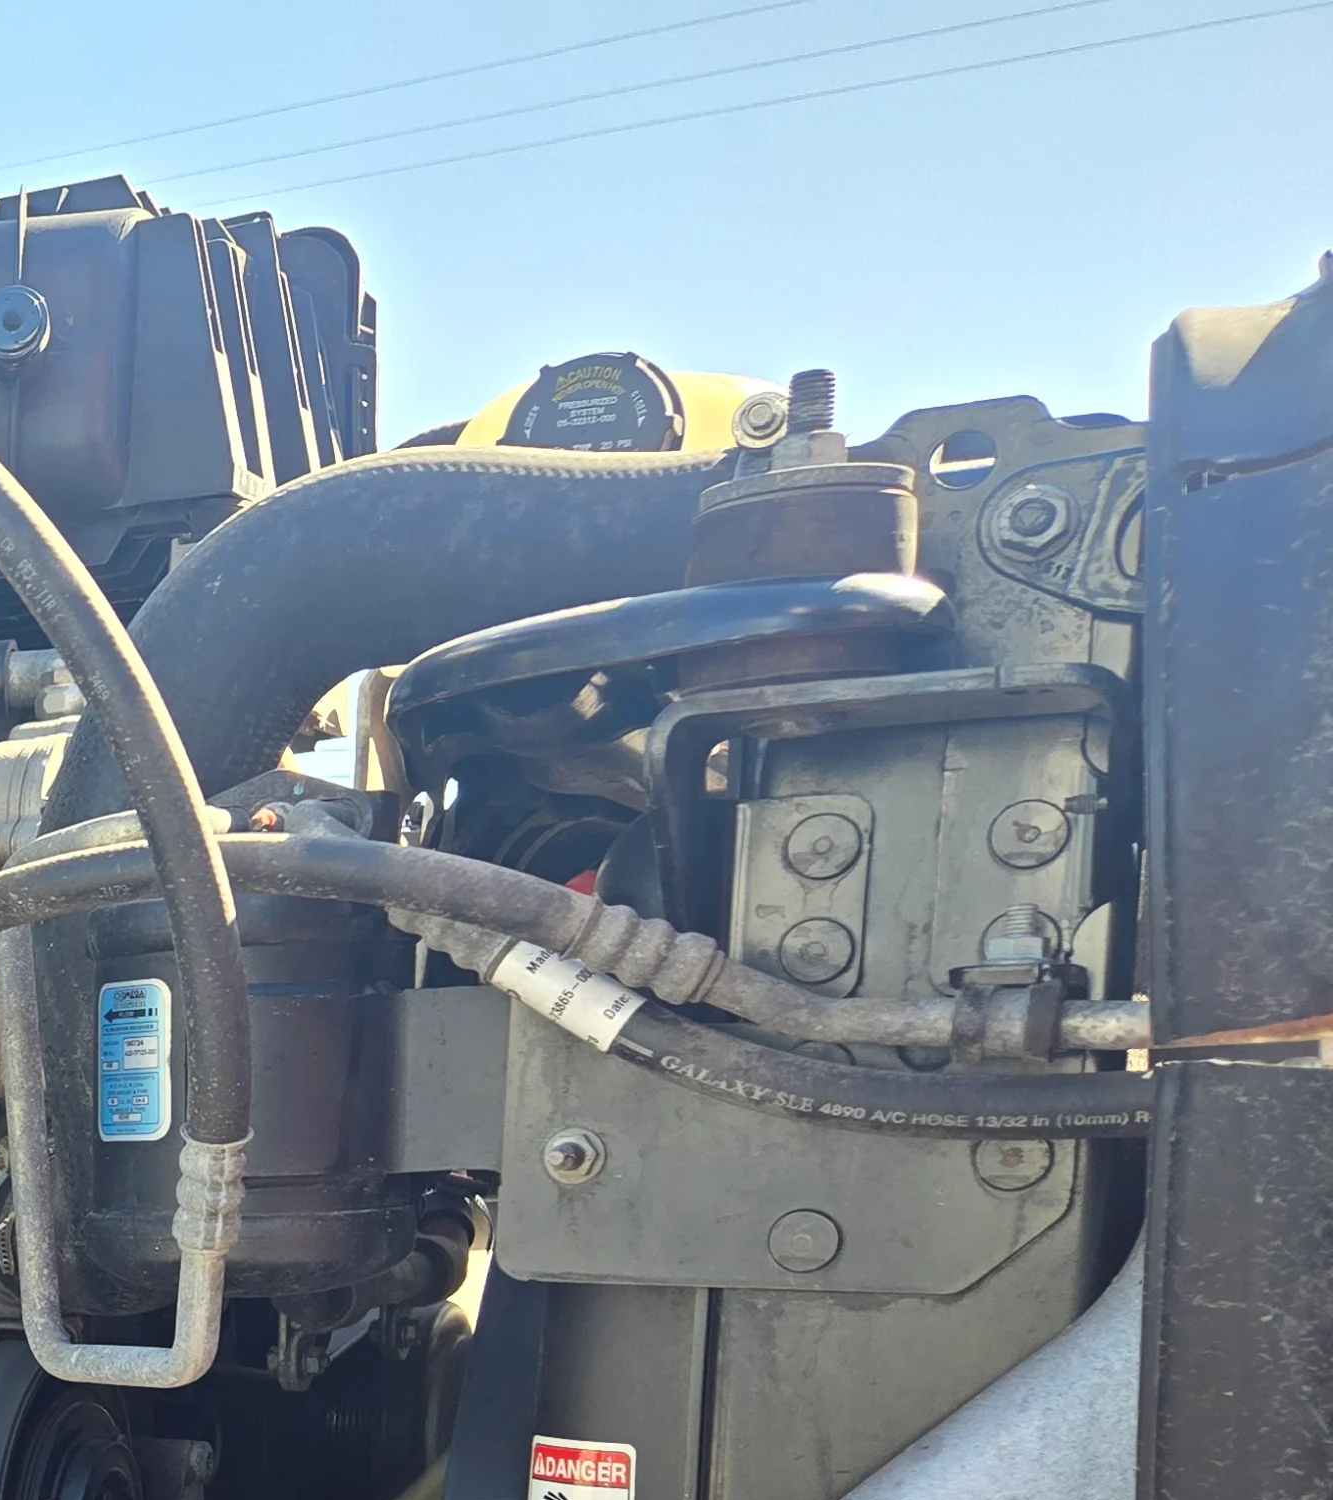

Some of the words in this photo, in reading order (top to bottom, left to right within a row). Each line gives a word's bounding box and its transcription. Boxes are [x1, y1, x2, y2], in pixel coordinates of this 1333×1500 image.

[567, 366, 622, 382] CAUTION
[557, 396, 618, 410] PRESSURIZED
[569, 407, 605, 418] SYSTEM
[660, 1055, 771, 1101] GALAXY
[774, 1091, 815, 1112] SLE
[818, 1102, 866, 1120] 4890
[869, 1109, 907, 1124] A/C
[911, 1114, 969, 1128] HOSE
[974, 1115, 1028, 1129] 13/32
[1031, 1115, 1050, 1127] in
[1055, 1112, 1130, 1129] (10mm)
[545, 1456, 627, 1484] DANGER
